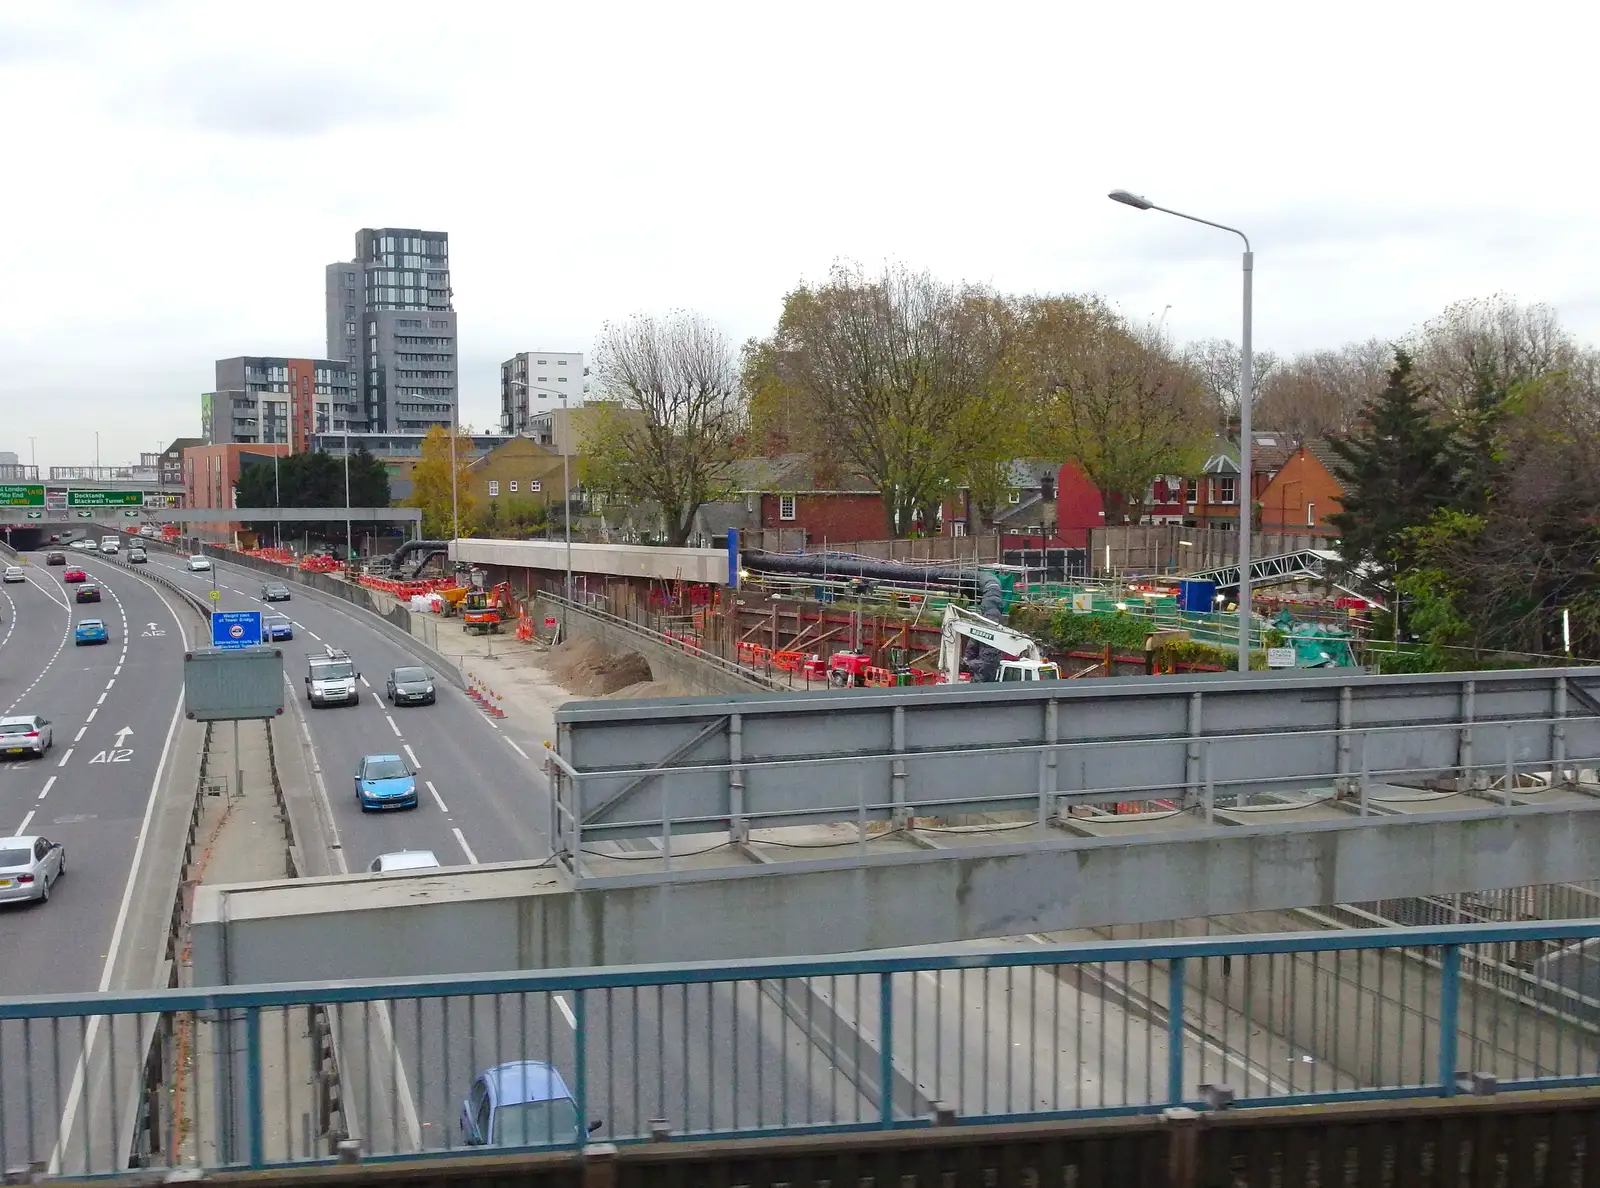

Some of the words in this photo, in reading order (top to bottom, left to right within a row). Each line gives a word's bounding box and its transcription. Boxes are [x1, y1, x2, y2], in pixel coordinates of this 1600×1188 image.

[141, 629, 166, 637] A12
[972, 628, 993, 640] MURPHY
[88, 749, 134, 765] A12
